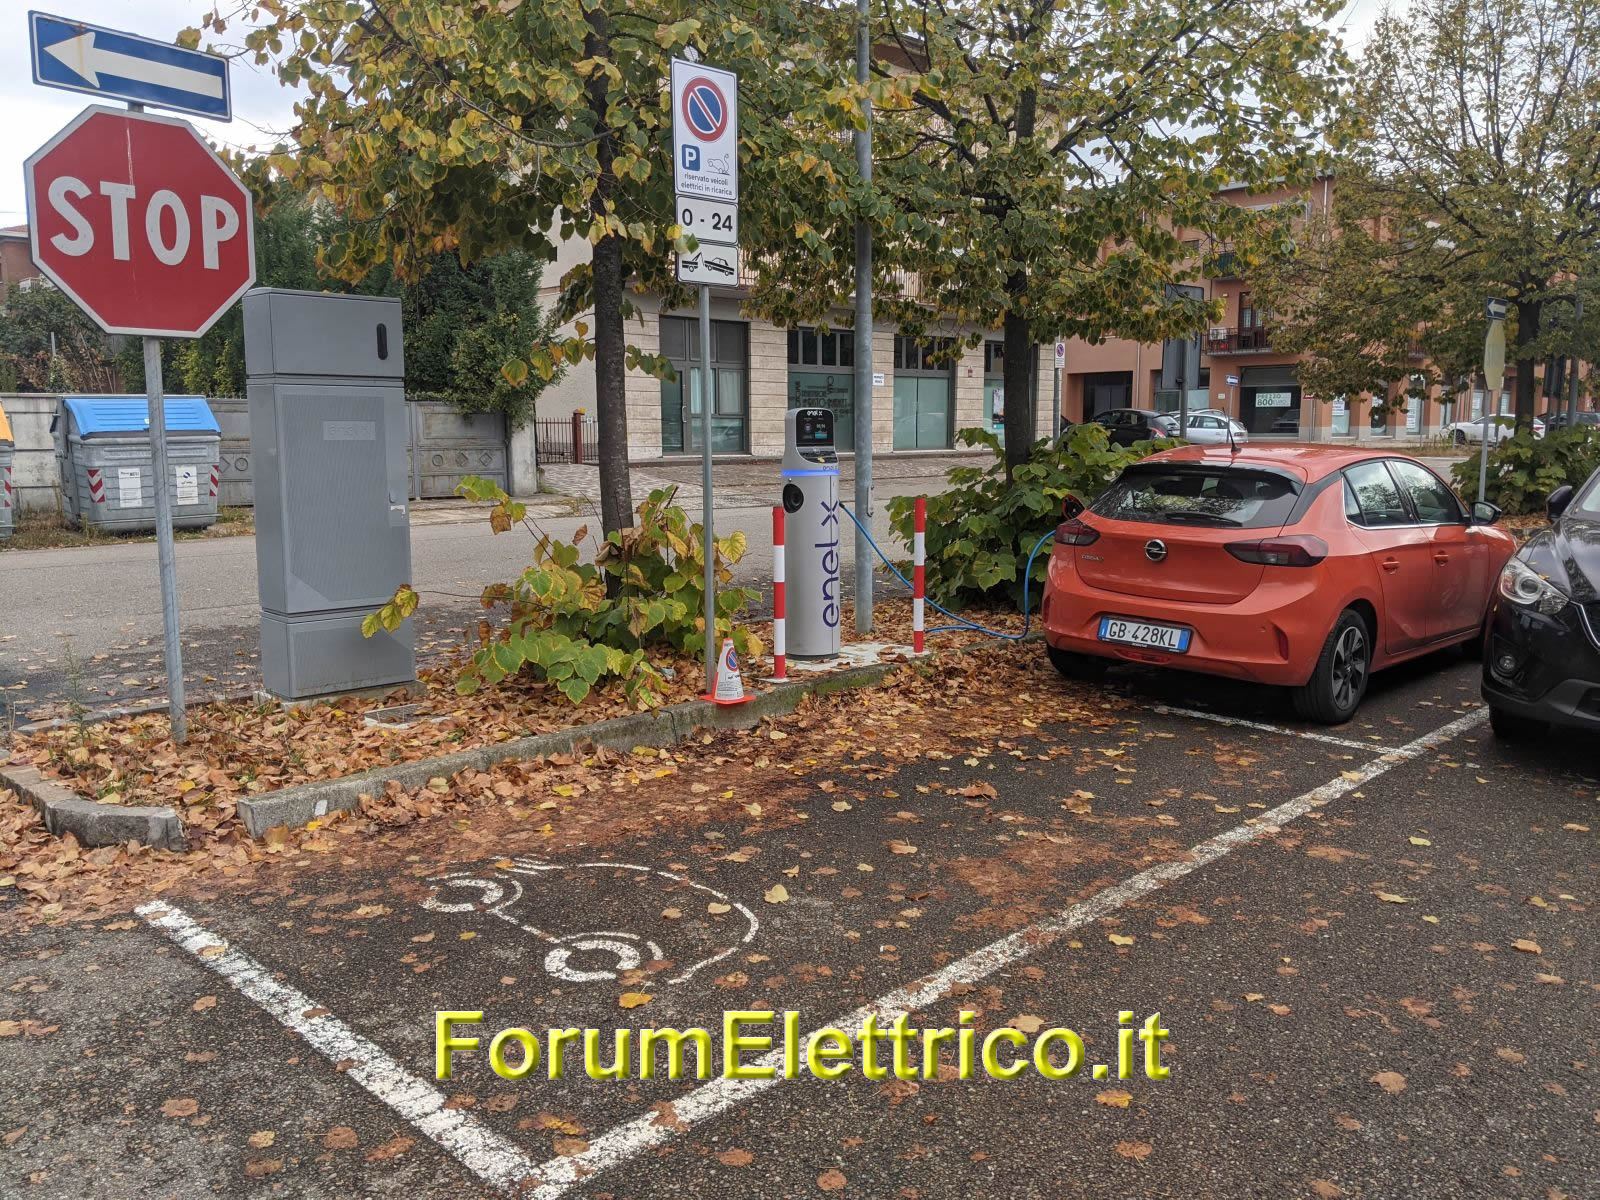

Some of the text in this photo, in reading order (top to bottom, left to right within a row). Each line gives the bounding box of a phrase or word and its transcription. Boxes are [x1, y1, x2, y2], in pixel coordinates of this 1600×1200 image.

[681, 181, 704, 191] elettrici
[711, 185, 733, 196] ricarica
[684, 172, 729, 186] riservato veicoli
[48, 175, 240, 270] STOP
[681, 208, 693, 227] 0
[711, 212, 733, 232] 24
[814, 539, 839, 628] enel
[1108, 621, 1127, 639] GB
[1131, 625, 1177, 647] 428KL
